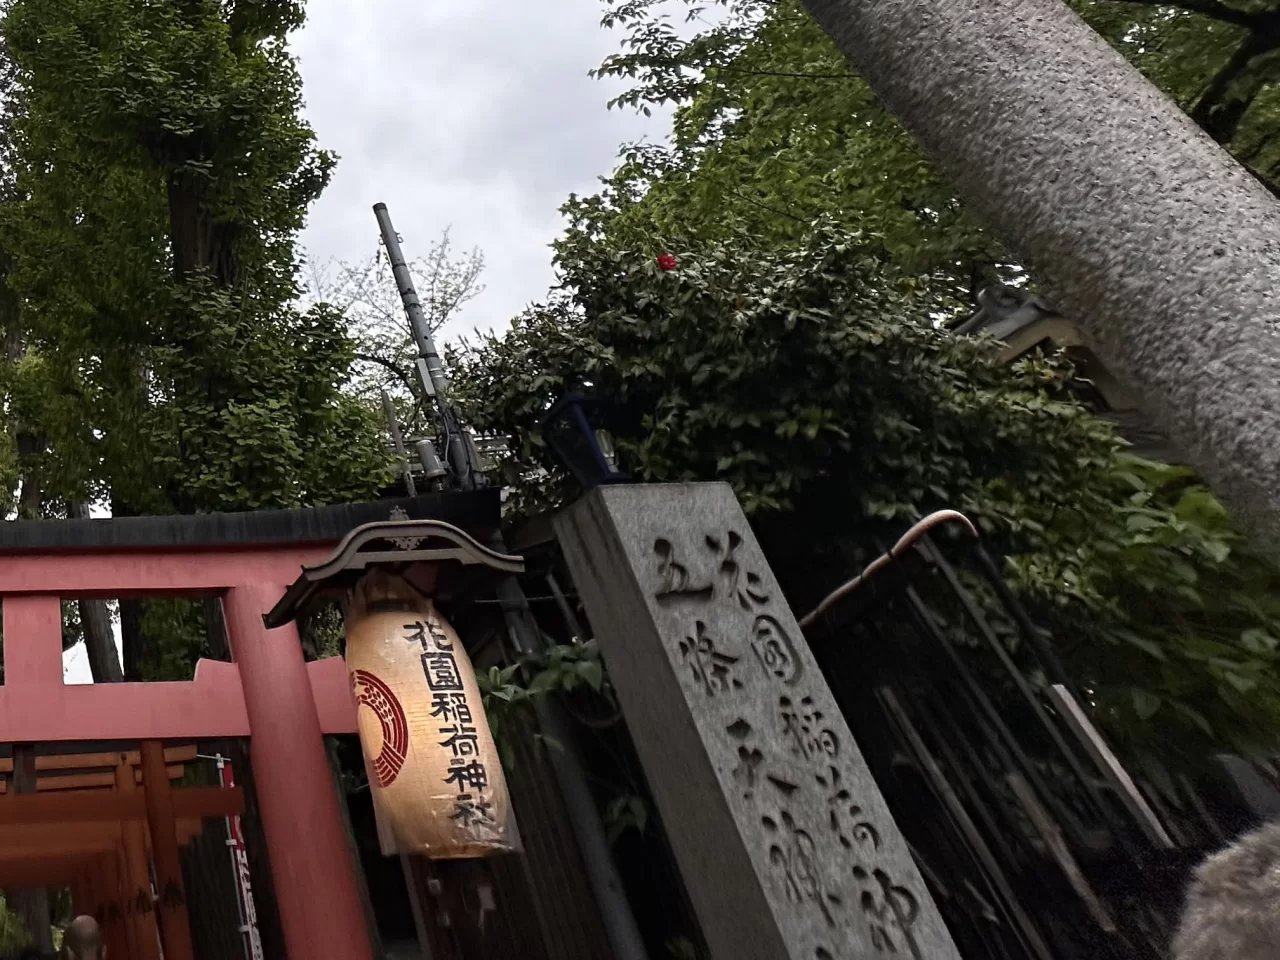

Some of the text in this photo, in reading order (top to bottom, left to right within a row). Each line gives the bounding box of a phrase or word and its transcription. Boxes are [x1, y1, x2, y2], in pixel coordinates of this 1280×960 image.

[402, 620, 494, 829] 花園稲荷神社
